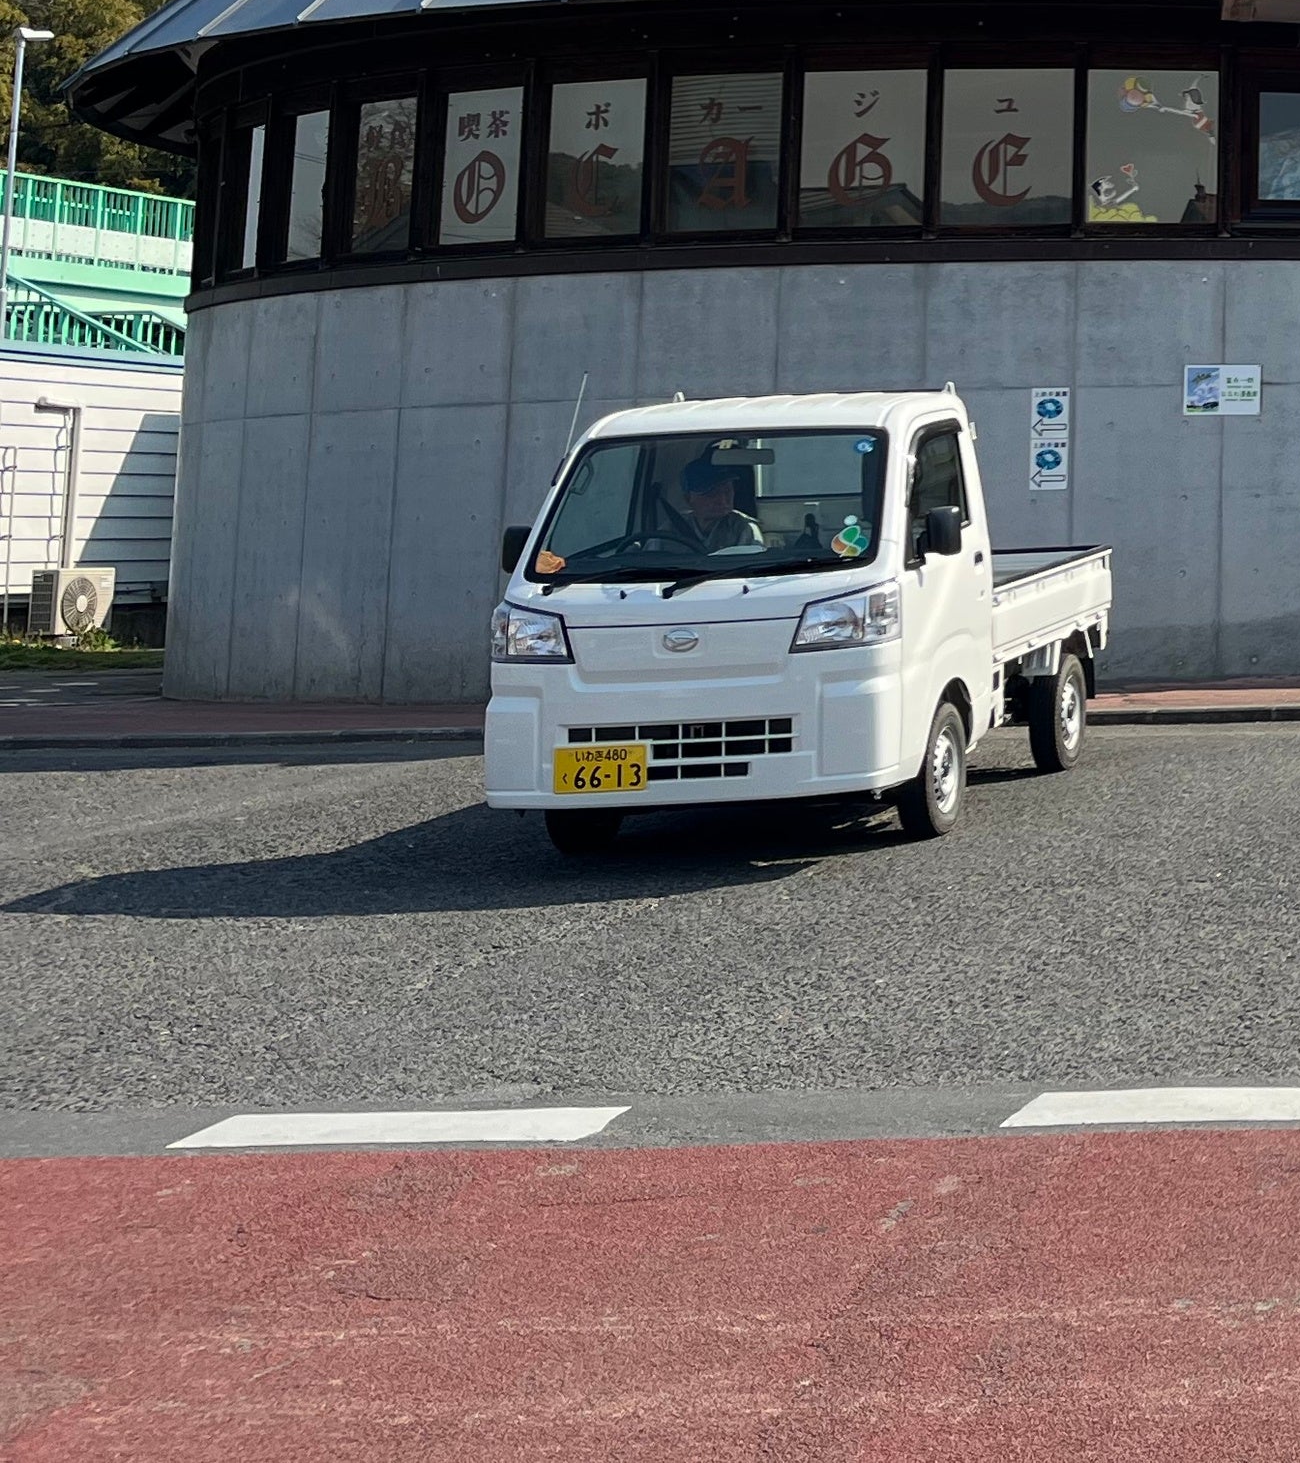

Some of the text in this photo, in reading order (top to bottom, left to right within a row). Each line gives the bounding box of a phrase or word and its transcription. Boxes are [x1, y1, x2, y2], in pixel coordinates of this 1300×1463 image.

[458, 110, 510, 142] 喫茶
[562, 763, 641, 789] く 66-13
